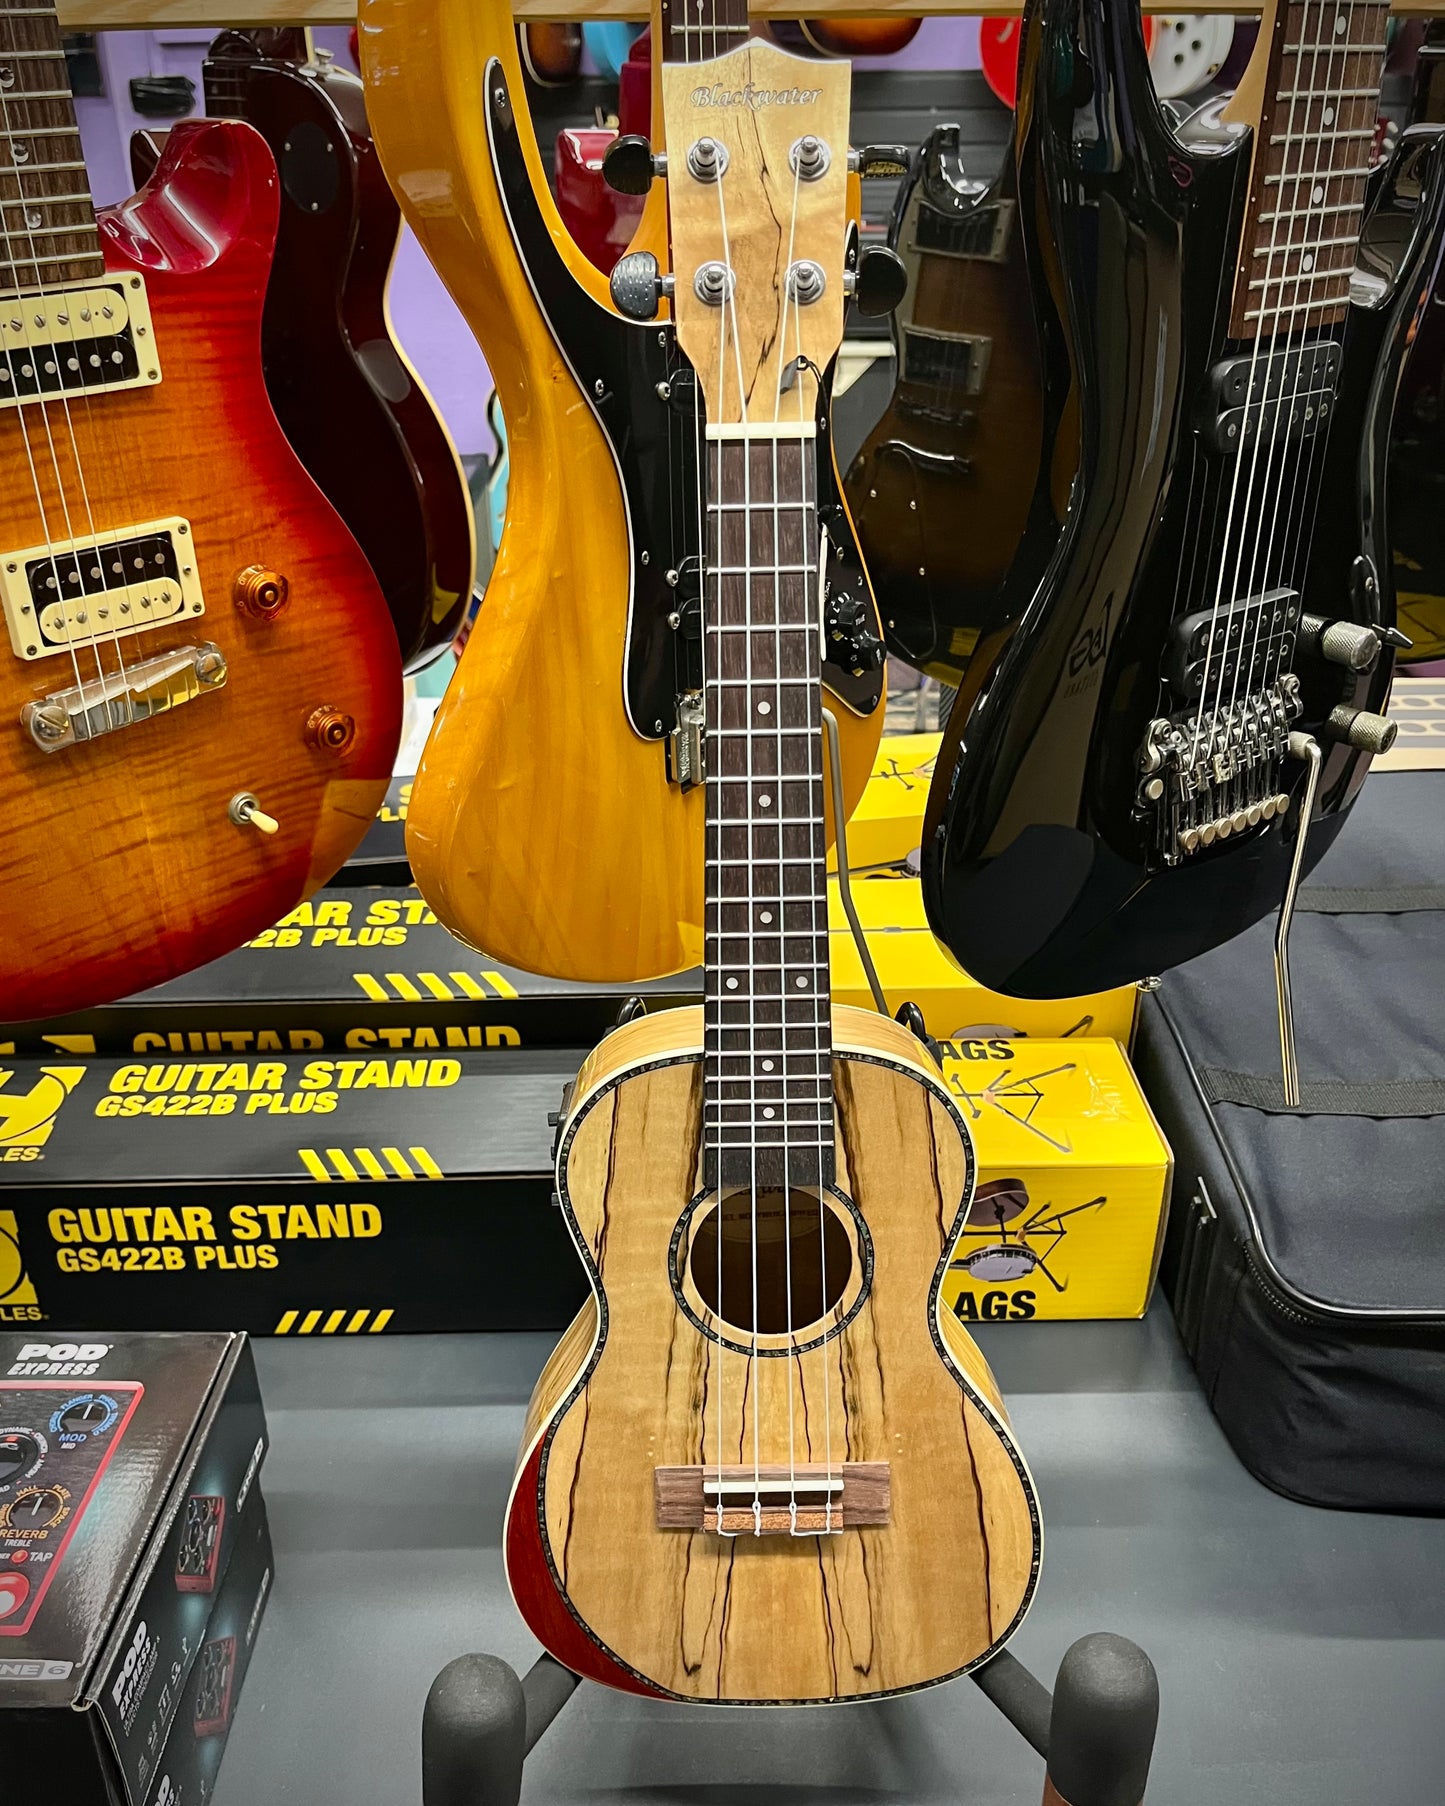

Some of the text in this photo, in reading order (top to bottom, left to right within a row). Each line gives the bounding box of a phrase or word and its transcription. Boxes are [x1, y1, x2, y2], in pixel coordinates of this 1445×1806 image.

[690, 82, 823, 111] Blackwater
[241, 926, 408, 948] 2B PLUS
[938, 1040, 1015, 1060] AGS
[109, 1058, 462, 1094] GUITAR STAND
[95, 1090, 339, 1117] GS422B PLUS
[0, 1147, 40, 1162] ES
[48, 1204, 383, 1243] GUITAR STAND
[56, 1244, 280, 1273] GS422B PLUS
[953, 1290, 1037, 1320] AGS
[16, 1343, 110, 1361] POD
[7, 1362, 101, 1376] EXPRESS
[58, 1433, 88, 1442] MOD
[60, 1442, 77, 1450] MID
[0, 1528, 49, 1539] REVERB
[4, 1539, 33, 1548] TREBLE
[29, 1551, 54, 1562] TAP
[48, 1665, 66, 1675] 6
[112, 1620, 147, 1707] POD
